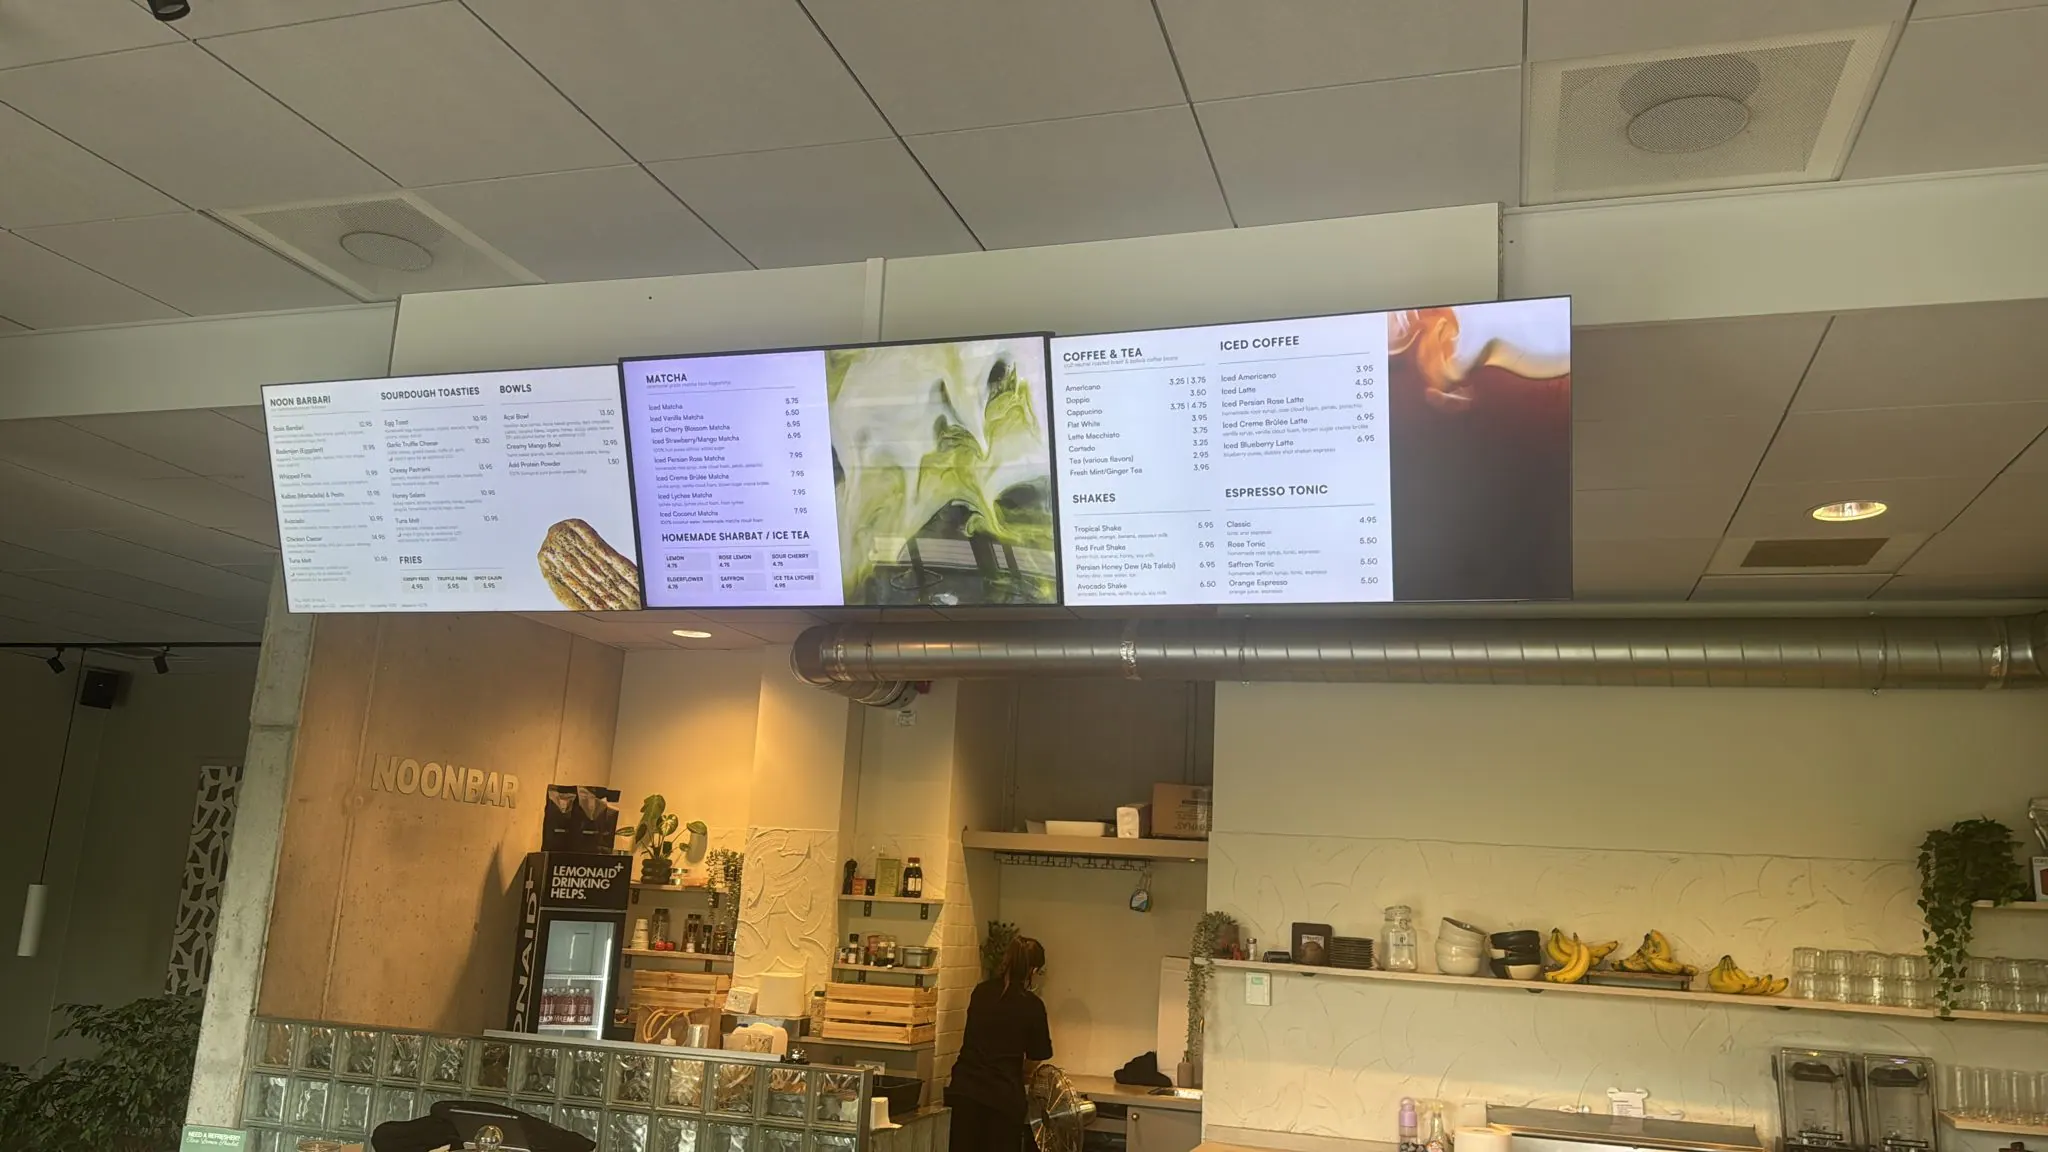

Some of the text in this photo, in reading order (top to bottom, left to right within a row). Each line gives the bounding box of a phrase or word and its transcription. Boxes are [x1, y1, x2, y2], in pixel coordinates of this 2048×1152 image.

[1220, 336, 1299, 351] ICED COFFEE
[1063, 348, 1143, 362] COFFEE & TEA
[646, 373, 688, 384] MATCHA
[1221, 365, 1374, 382] Iced Americano 3.95
[1169, 378, 1185, 386] 3.25
[1191, 376, 1206, 384] 3.75
[1222, 386, 1237, 395] Iced
[1355, 378, 1374, 386] 4.50
[381, 387, 480, 400] SOURDOUGH TOASTIES
[500, 384, 532, 394] BOWLS
[270, 395, 331, 407] NOON BARBARI
[1066, 389, 1207, 405] Doppio 3.50
[1222, 400, 1237, 408] Iced
[1239, 399, 1265, 407] Persian
[1356, 391, 1374, 400] 6.95
[1191, 401, 1207, 409] 4.75
[1081, 420, 1100, 428] White
[1192, 414, 1208, 422] 3.95
[1223, 421, 1238, 429] Iced
[1357, 413, 1375, 421] 6.95
[1086, 432, 1120, 440] Macchiato
[1240, 441, 1275, 449] Blueberry
[1357, 435, 1375, 443] 6.95
[1069, 445, 1096, 453] Cortado
[1083, 456, 1109, 466] (various
[1193, 451, 1209, 459] 2.95
[1070, 468, 1088, 476] Fresh
[1090, 468, 1129, 476] Mint/Ginger
[1226, 484, 1328, 498] ESPRESSO TONIC
[1072, 493, 1116, 504] SHAKES
[1360, 516, 1377, 524] 4.95
[1074, 525, 1101, 534] Tropical
[662, 532, 718, 542] HOMEMADE
[719, 531, 764, 541] SHARBAT
[772, 531, 789, 540] ICE
[791, 531, 810, 540] TEA
[1246, 540, 1265, 548] Tonic
[399, 556, 423, 564] FRIES
[1102, 564, 1123, 572] Honey
[1229, 579, 1255, 588] Orange
[1257, 579, 1288, 587] Espresso
[371, 753, 519, 809] NOONBAR
[551, 877, 611, 890] DRINKING
[550, 887, 587, 900] HELPS.
